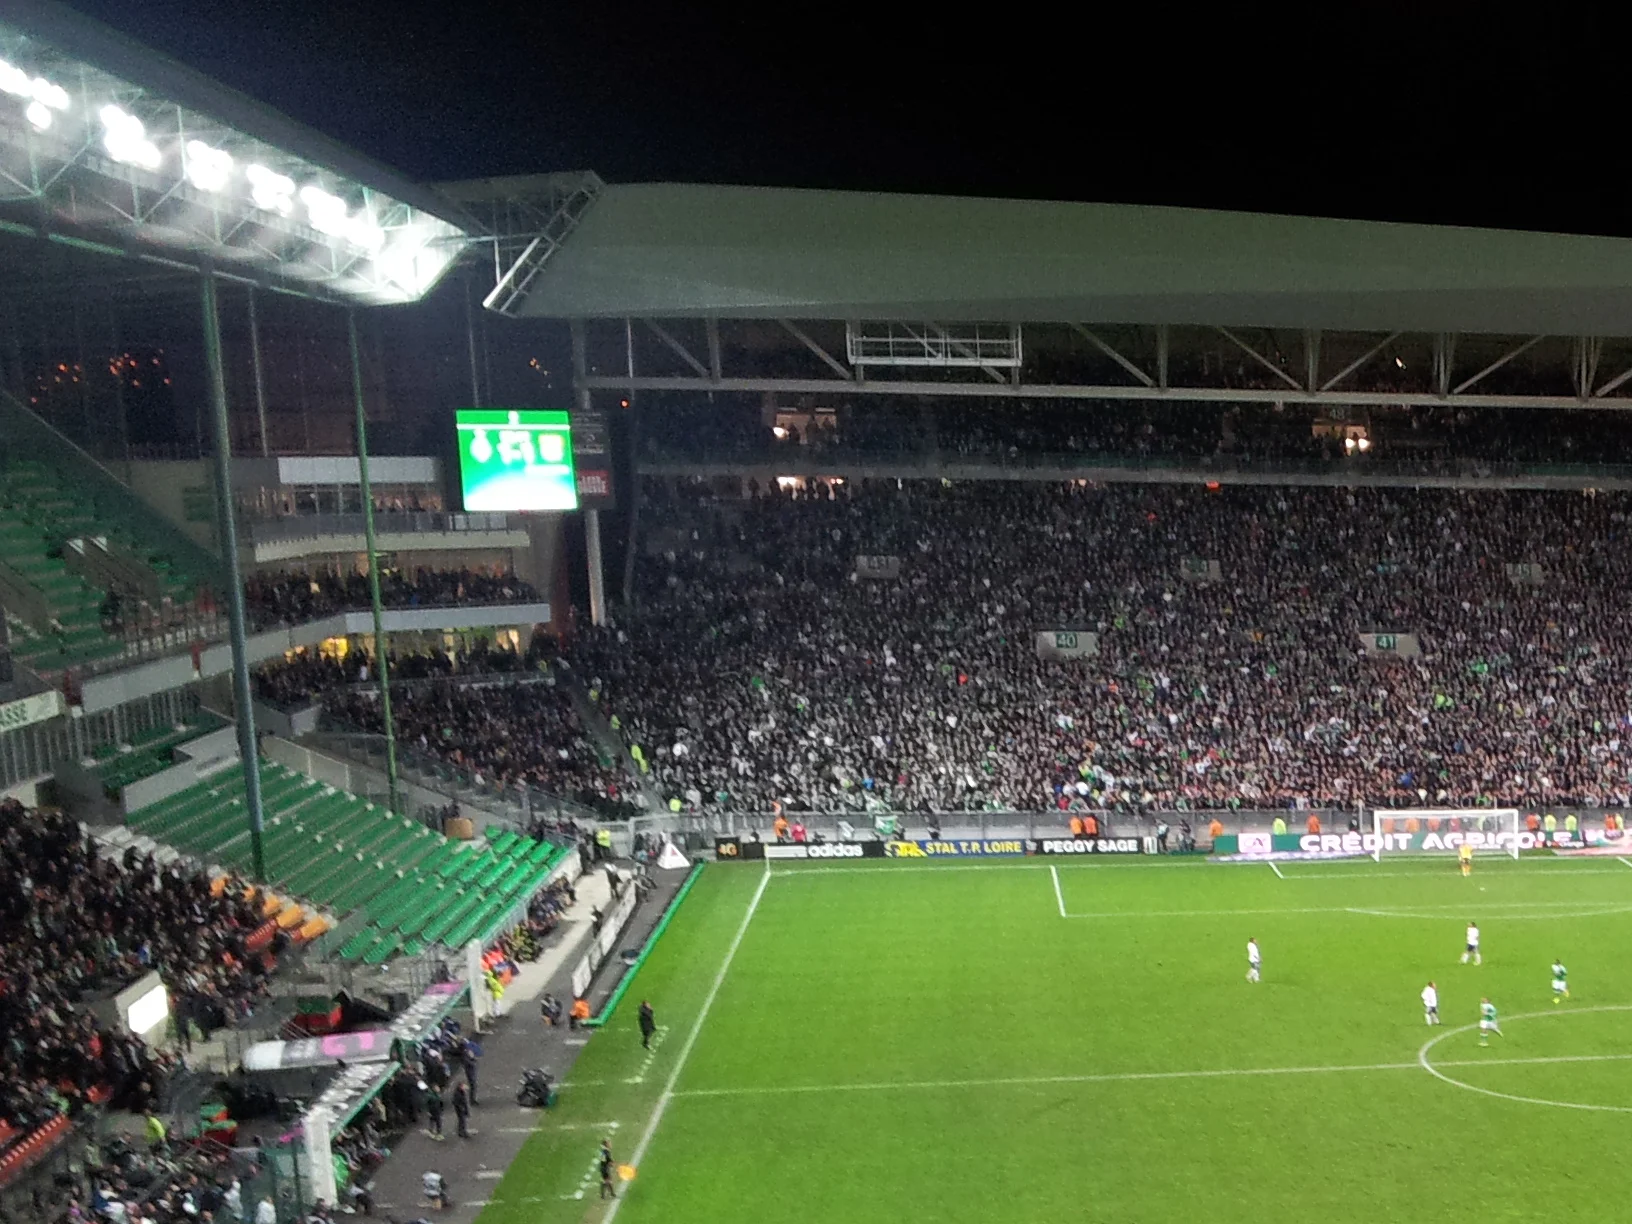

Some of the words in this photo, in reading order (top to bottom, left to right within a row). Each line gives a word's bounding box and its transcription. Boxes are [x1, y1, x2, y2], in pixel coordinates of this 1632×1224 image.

[1057, 633, 1077, 647] 40
[1377, 635, 1395, 649] 41
[983, 841, 1023, 854] LOIRE
[1043, 839, 1093, 853] PEGGY
[1097, 839, 1138, 852] SAGE
[1300, 830, 1413, 851] CRÉDIT
[808, 842, 864, 857] adidas
